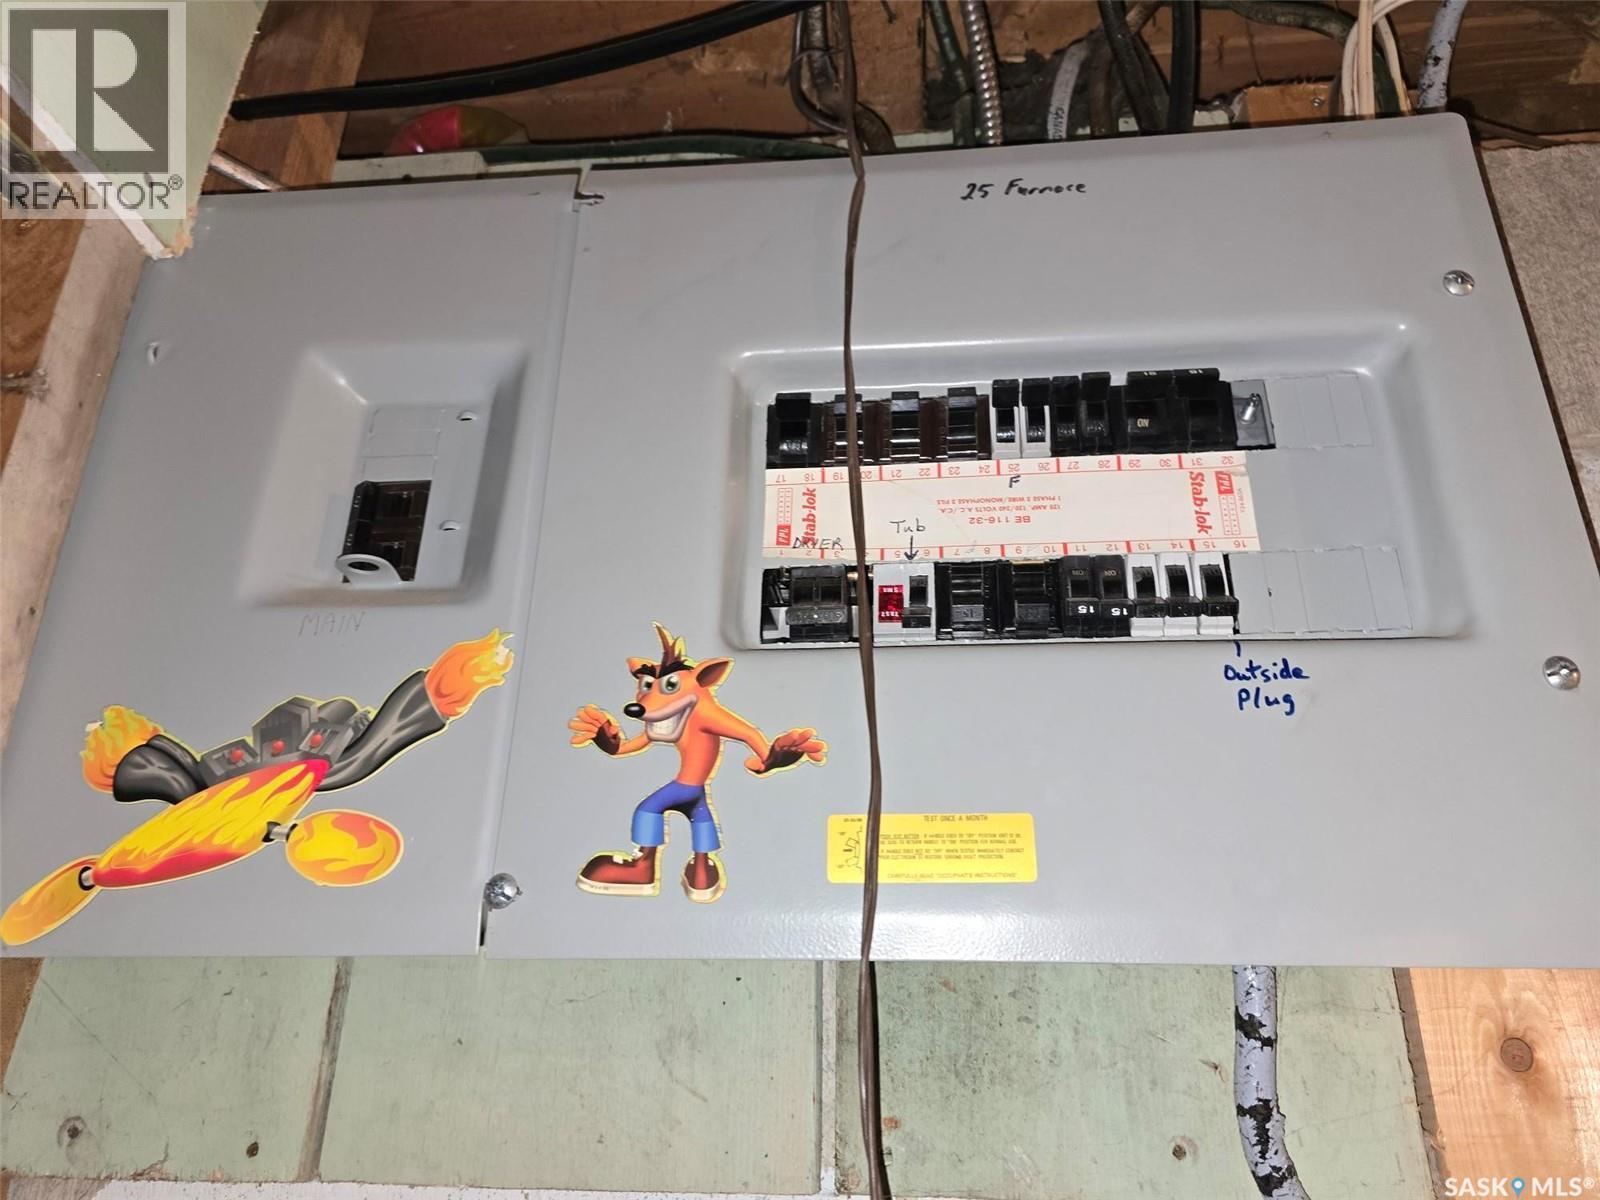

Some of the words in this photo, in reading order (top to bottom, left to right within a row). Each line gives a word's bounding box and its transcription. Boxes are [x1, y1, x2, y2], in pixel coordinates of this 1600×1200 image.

[960, 183, 995, 201] 25
[1136, 418, 1149, 428] ON
[775, 474, 786, 483] 17
[804, 473, 815, 482] 18
[833, 472, 844, 480] 19
[860, 470, 872, 480] 20
[891, 469, 902, 478] 21
[919, 468, 930, 476] 22
[948, 466, 960, 475] 23
[978, 465, 990, 474] 24
[1008, 464, 1020, 472] 25
[1038, 462, 1050, 471] 26
[1067, 461, 1079, 470] 27
[1098, 460, 1110, 468] 28
[1129, 459, 1141, 468] 29
[1160, 458, 1171, 468] 30
[1192, 458, 1202, 466] 31
[1222, 456, 1234, 464] 32
[1009, 475, 1021, 489] F
[889, 517, 926, 534] Tub
[968, 516, 1009, 524] 116-32
[1014, 515, 1031, 523] BE
[894, 550, 900, 558] 5
[1016, 546, 1022, 554] 9
[1044, 545, 1056, 554] 10
[1075, 544, 1087, 552] 11
[1106, 544, 1119, 552] 12
[1138, 542, 1152, 550] 13
[1170, 541, 1184, 549] 14
[1203, 540, 1216, 548] 15
[1233, 540, 1247, 548] 16
[1077, 605, 1095, 614] 15
[1111, 607, 1129, 616] 15
[1224, 658, 1310, 683] Outside
